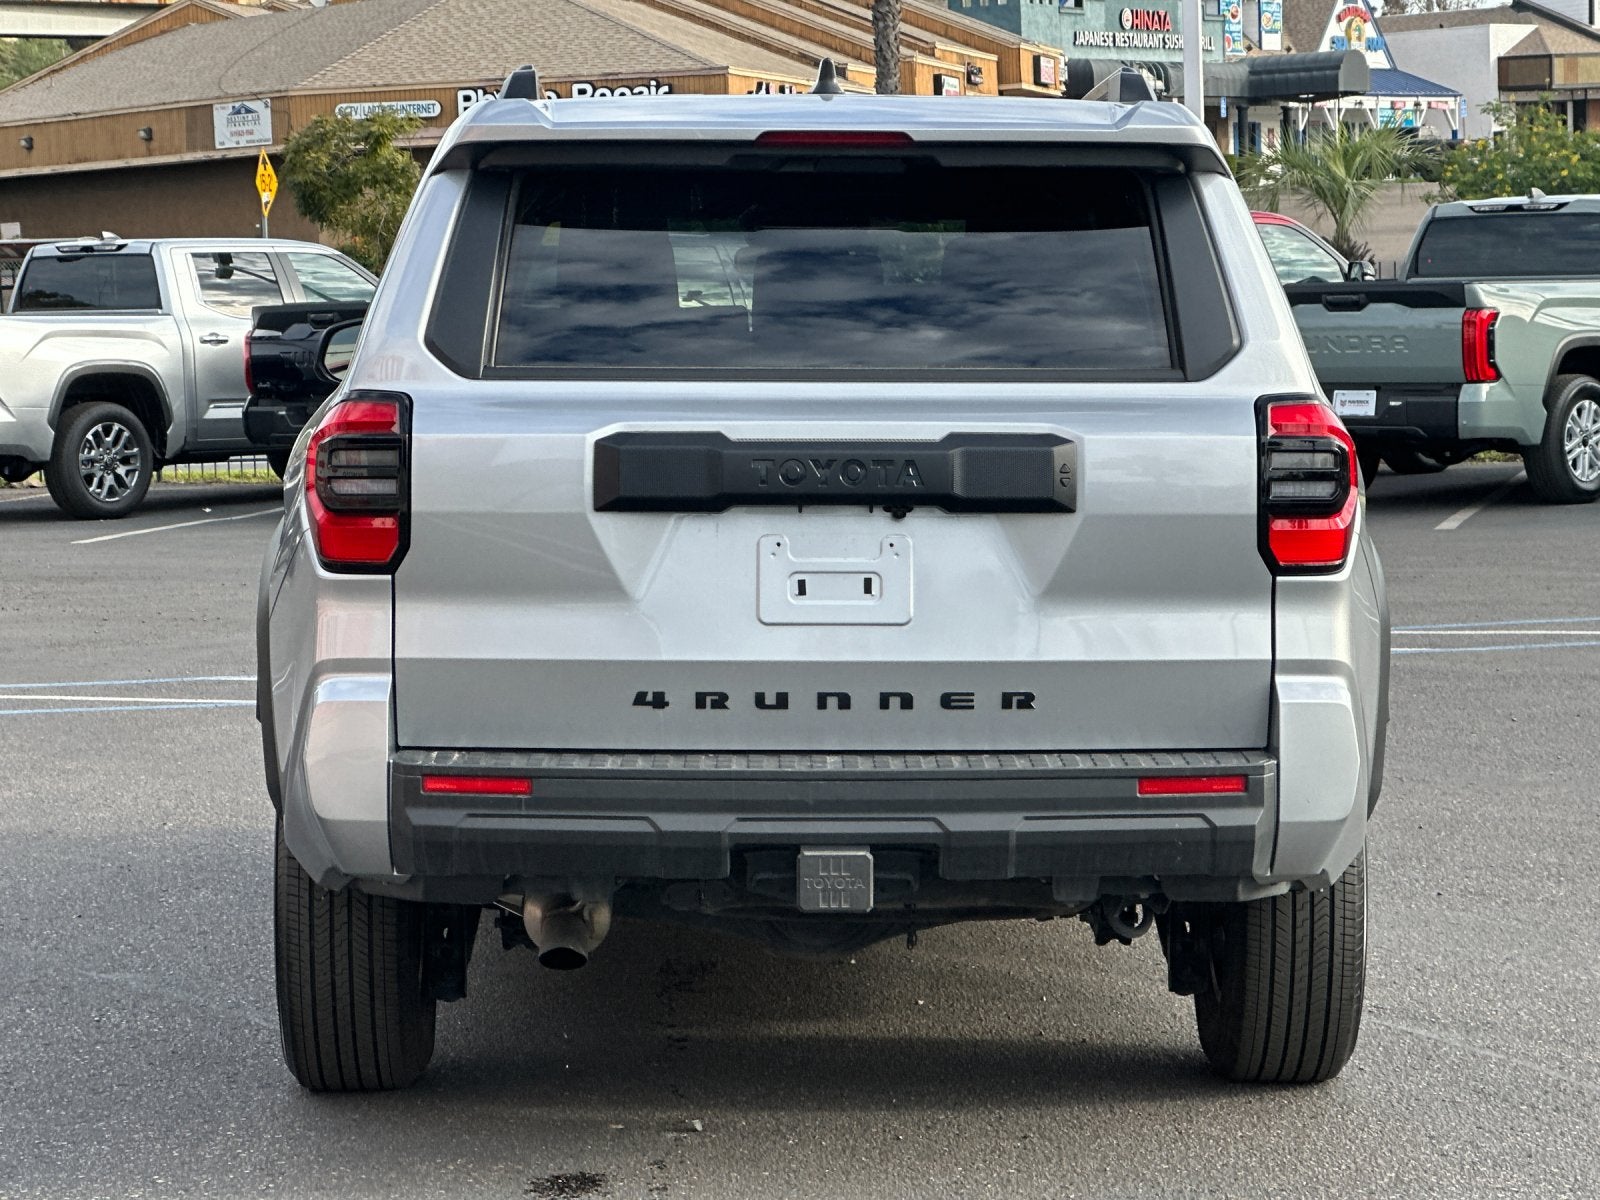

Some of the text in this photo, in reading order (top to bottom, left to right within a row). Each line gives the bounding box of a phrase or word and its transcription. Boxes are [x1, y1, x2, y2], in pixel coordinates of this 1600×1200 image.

[1133, 9, 1172, 31] HINATA
[1075, 31, 1216, 50] JAPANESE RESTAURANT SUSH RILL
[399, 103, 437, 115] INTERNET
[1301, 335, 1409, 354] UNDRA
[751, 458, 925, 488] TOYOTA
[632, 691, 1037, 710] 4RUNNER
[803, 878, 866, 889] TOYOTA
